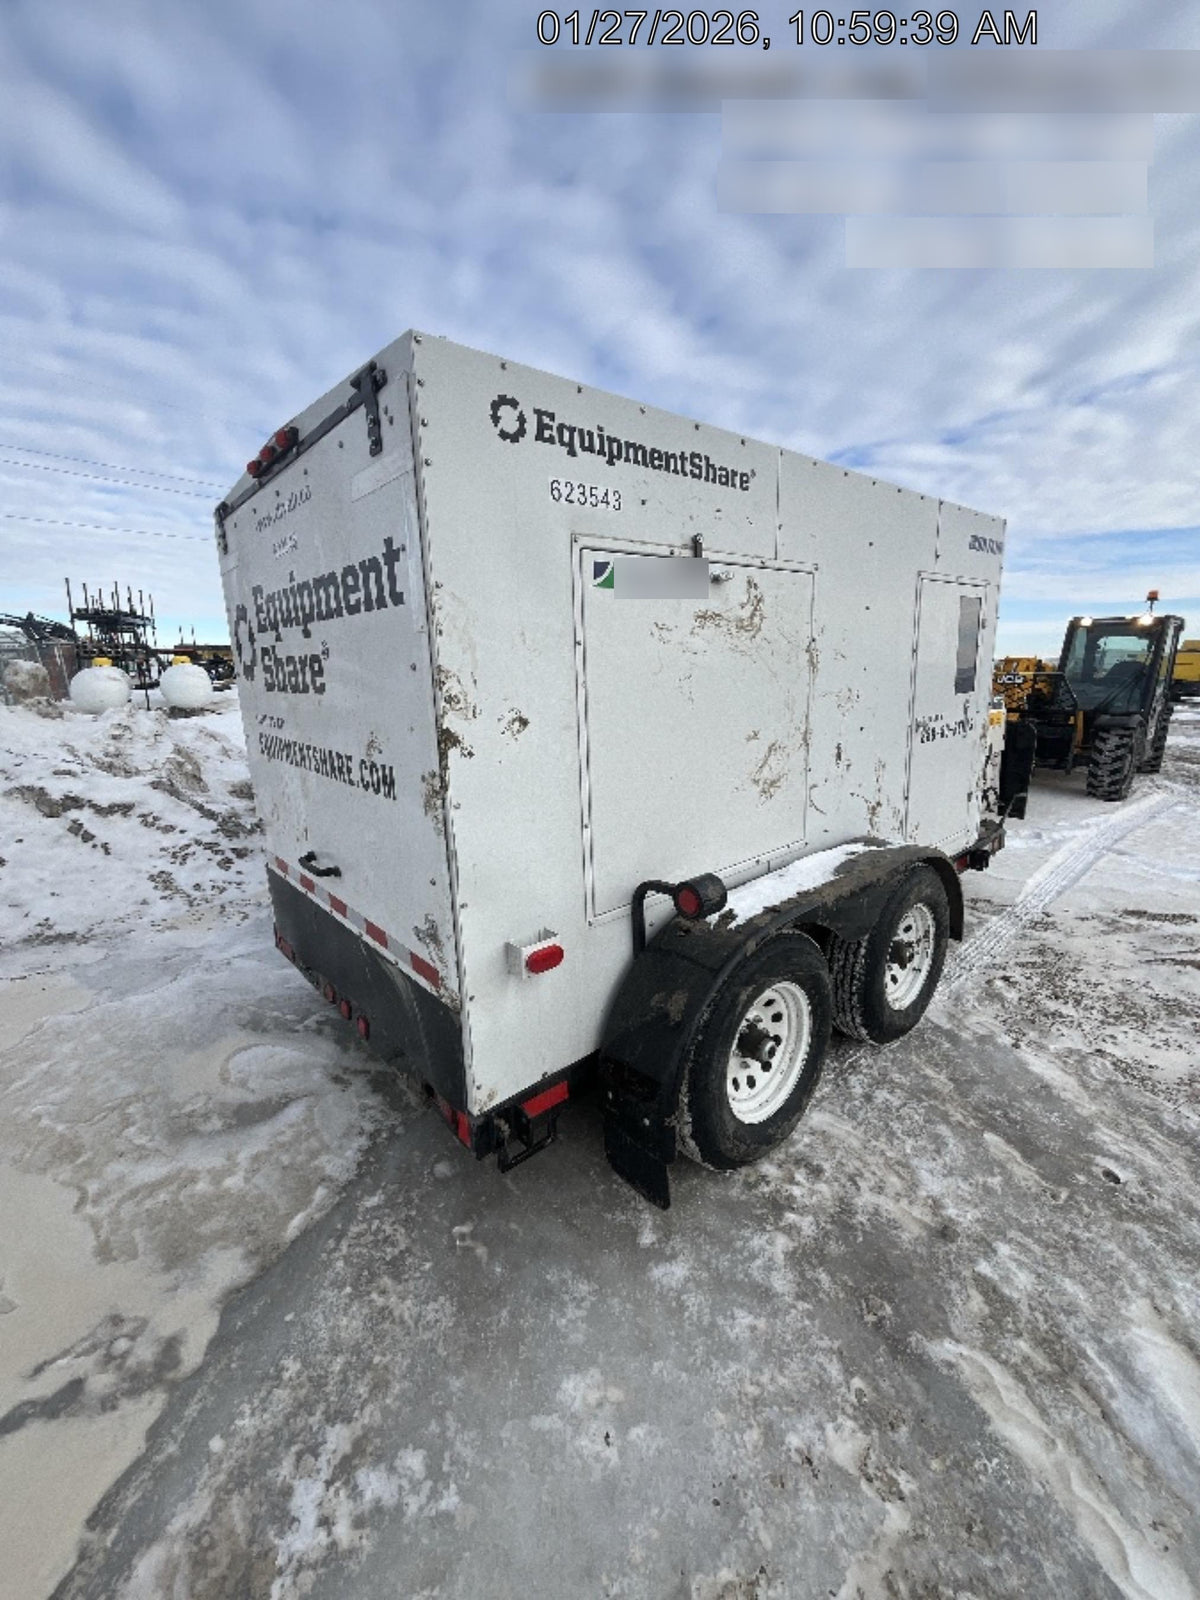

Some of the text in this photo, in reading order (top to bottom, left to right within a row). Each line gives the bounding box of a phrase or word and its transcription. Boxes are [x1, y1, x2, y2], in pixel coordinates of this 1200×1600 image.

[533, 407, 751, 491] EquipmentShare
[550, 479, 622, 511] 623543
[252, 536, 405, 642] Equipment
[261, 645, 326, 694] Share
[258, 732, 397, 801] EQUIPMENTSHARE.COM
